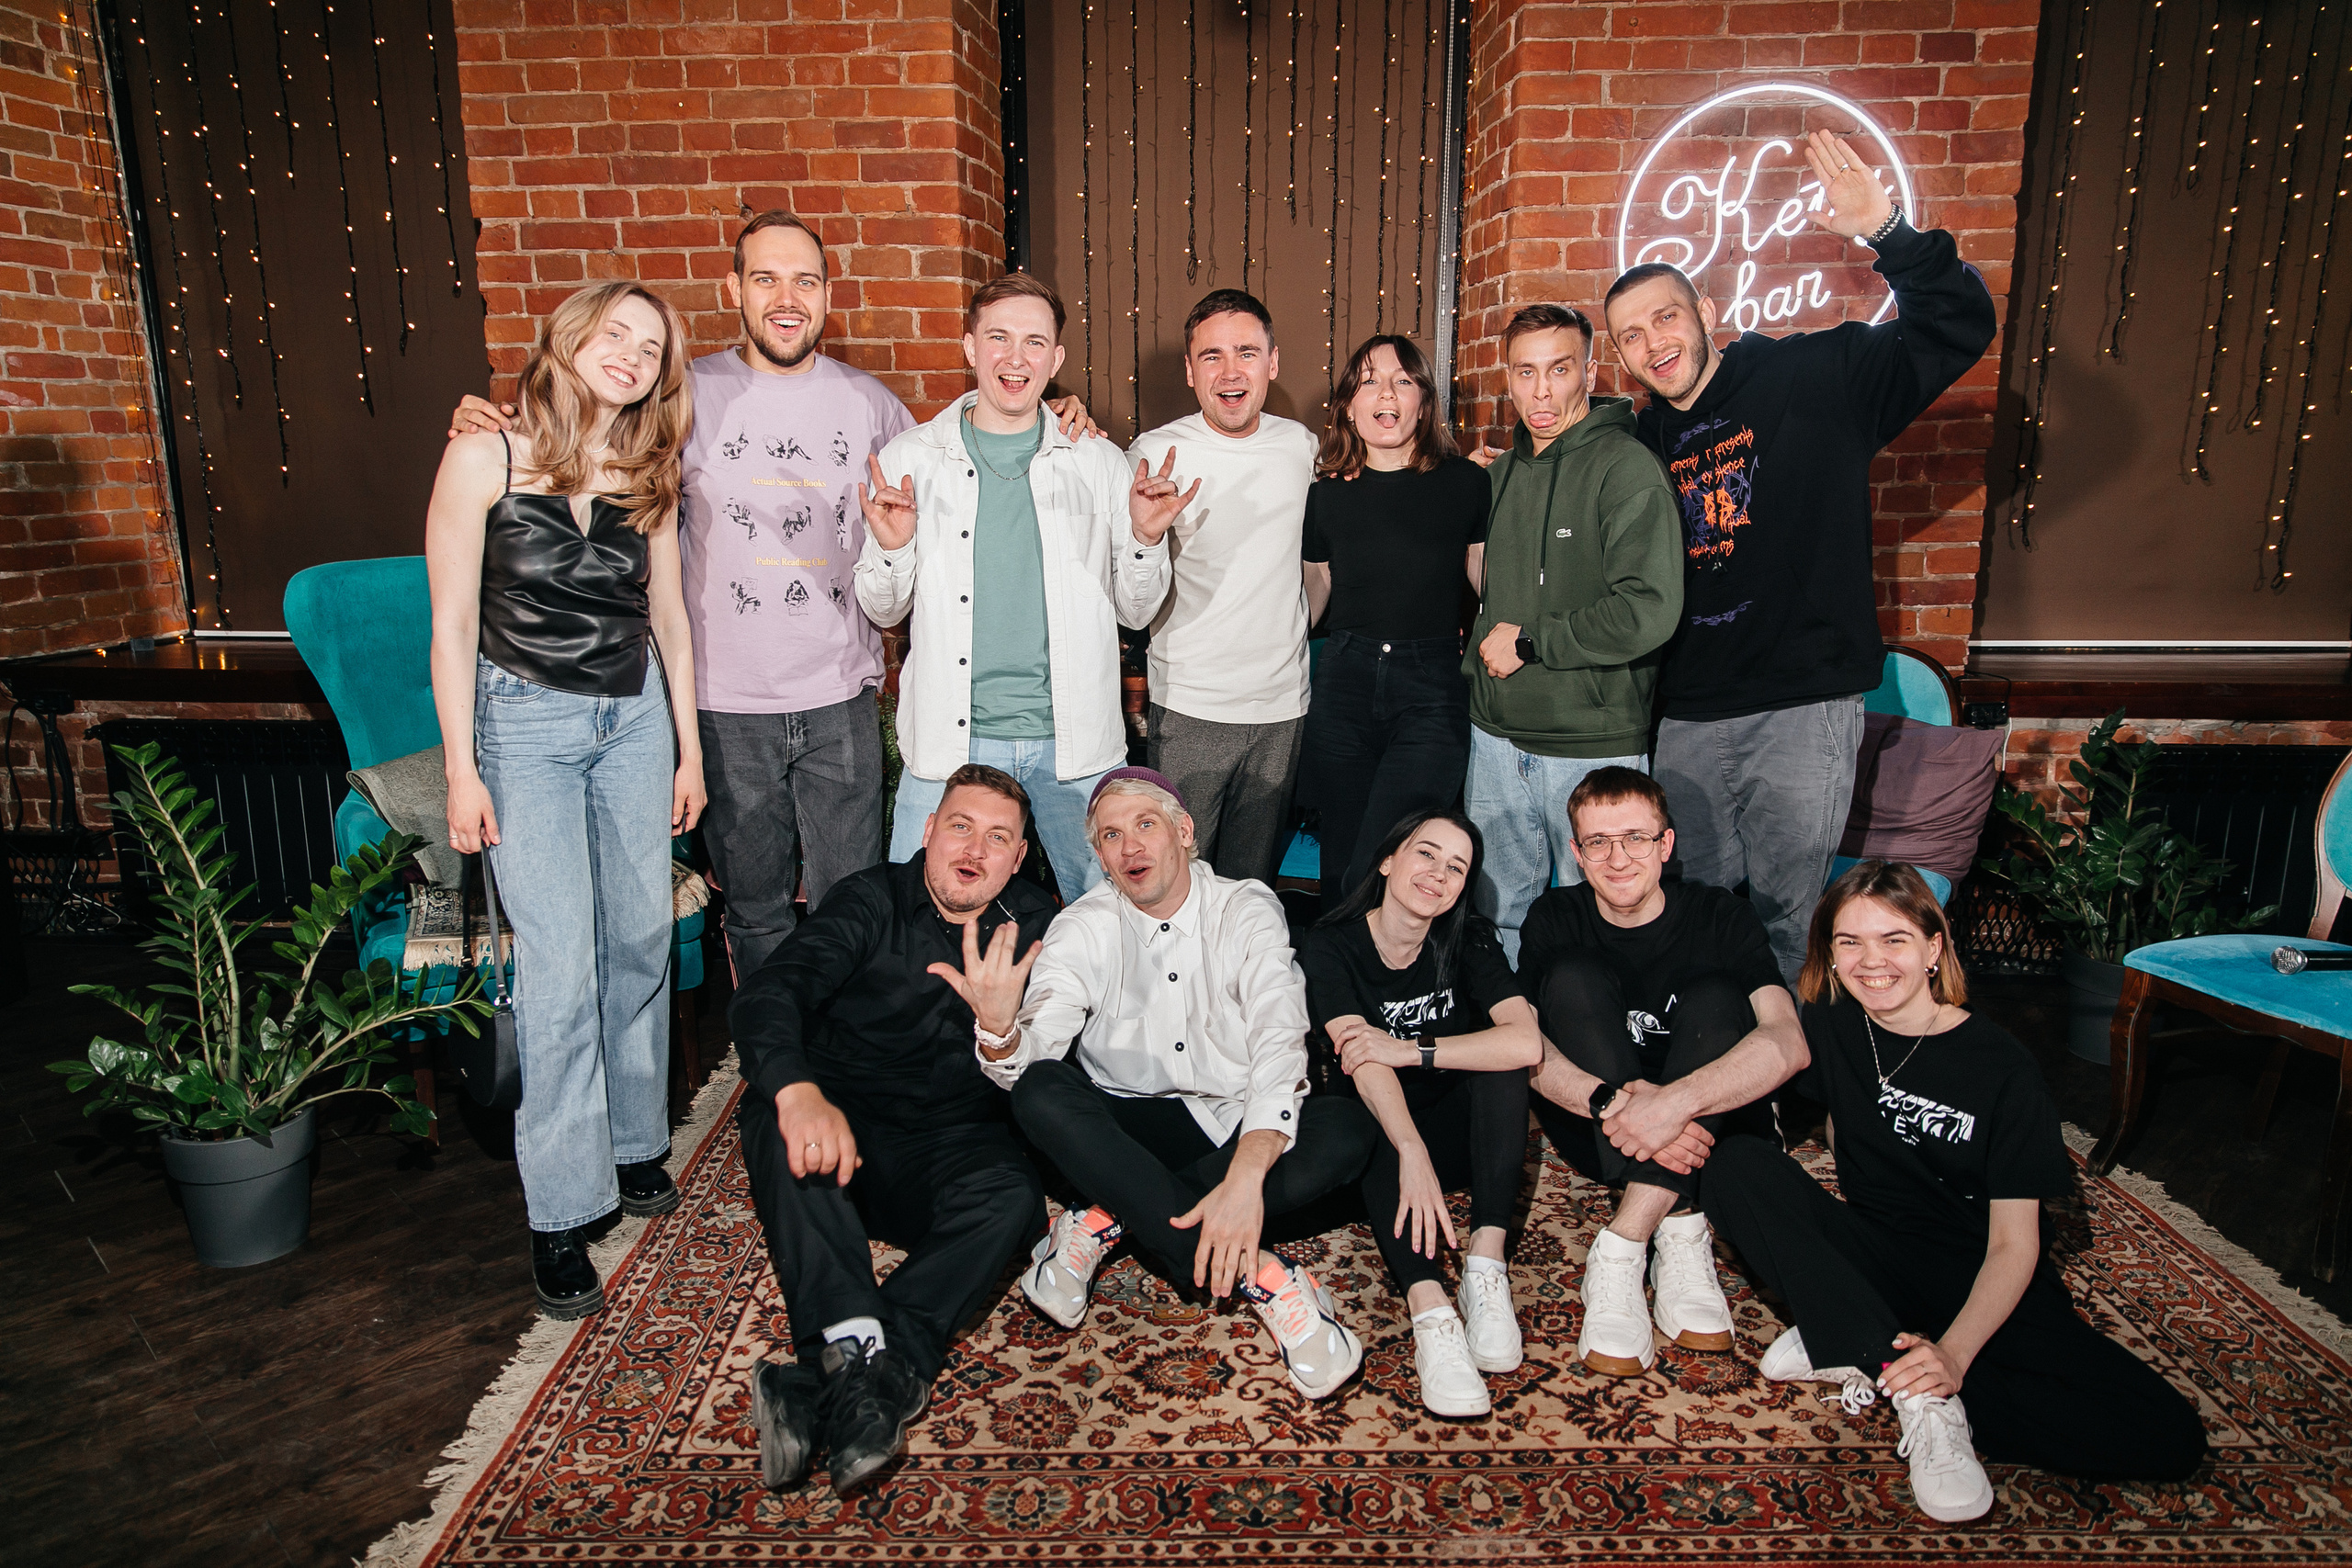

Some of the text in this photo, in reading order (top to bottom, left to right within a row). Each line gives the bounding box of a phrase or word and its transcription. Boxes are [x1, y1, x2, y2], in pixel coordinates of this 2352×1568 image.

[1722, 260, 1831, 332] bar
[1705, 423, 1754, 462] rpresents
[752, 477, 827, 488] Actual Source Books
[1702, 457, 1746, 487] exstence
[755, 557, 828, 568] Public Reading Club
